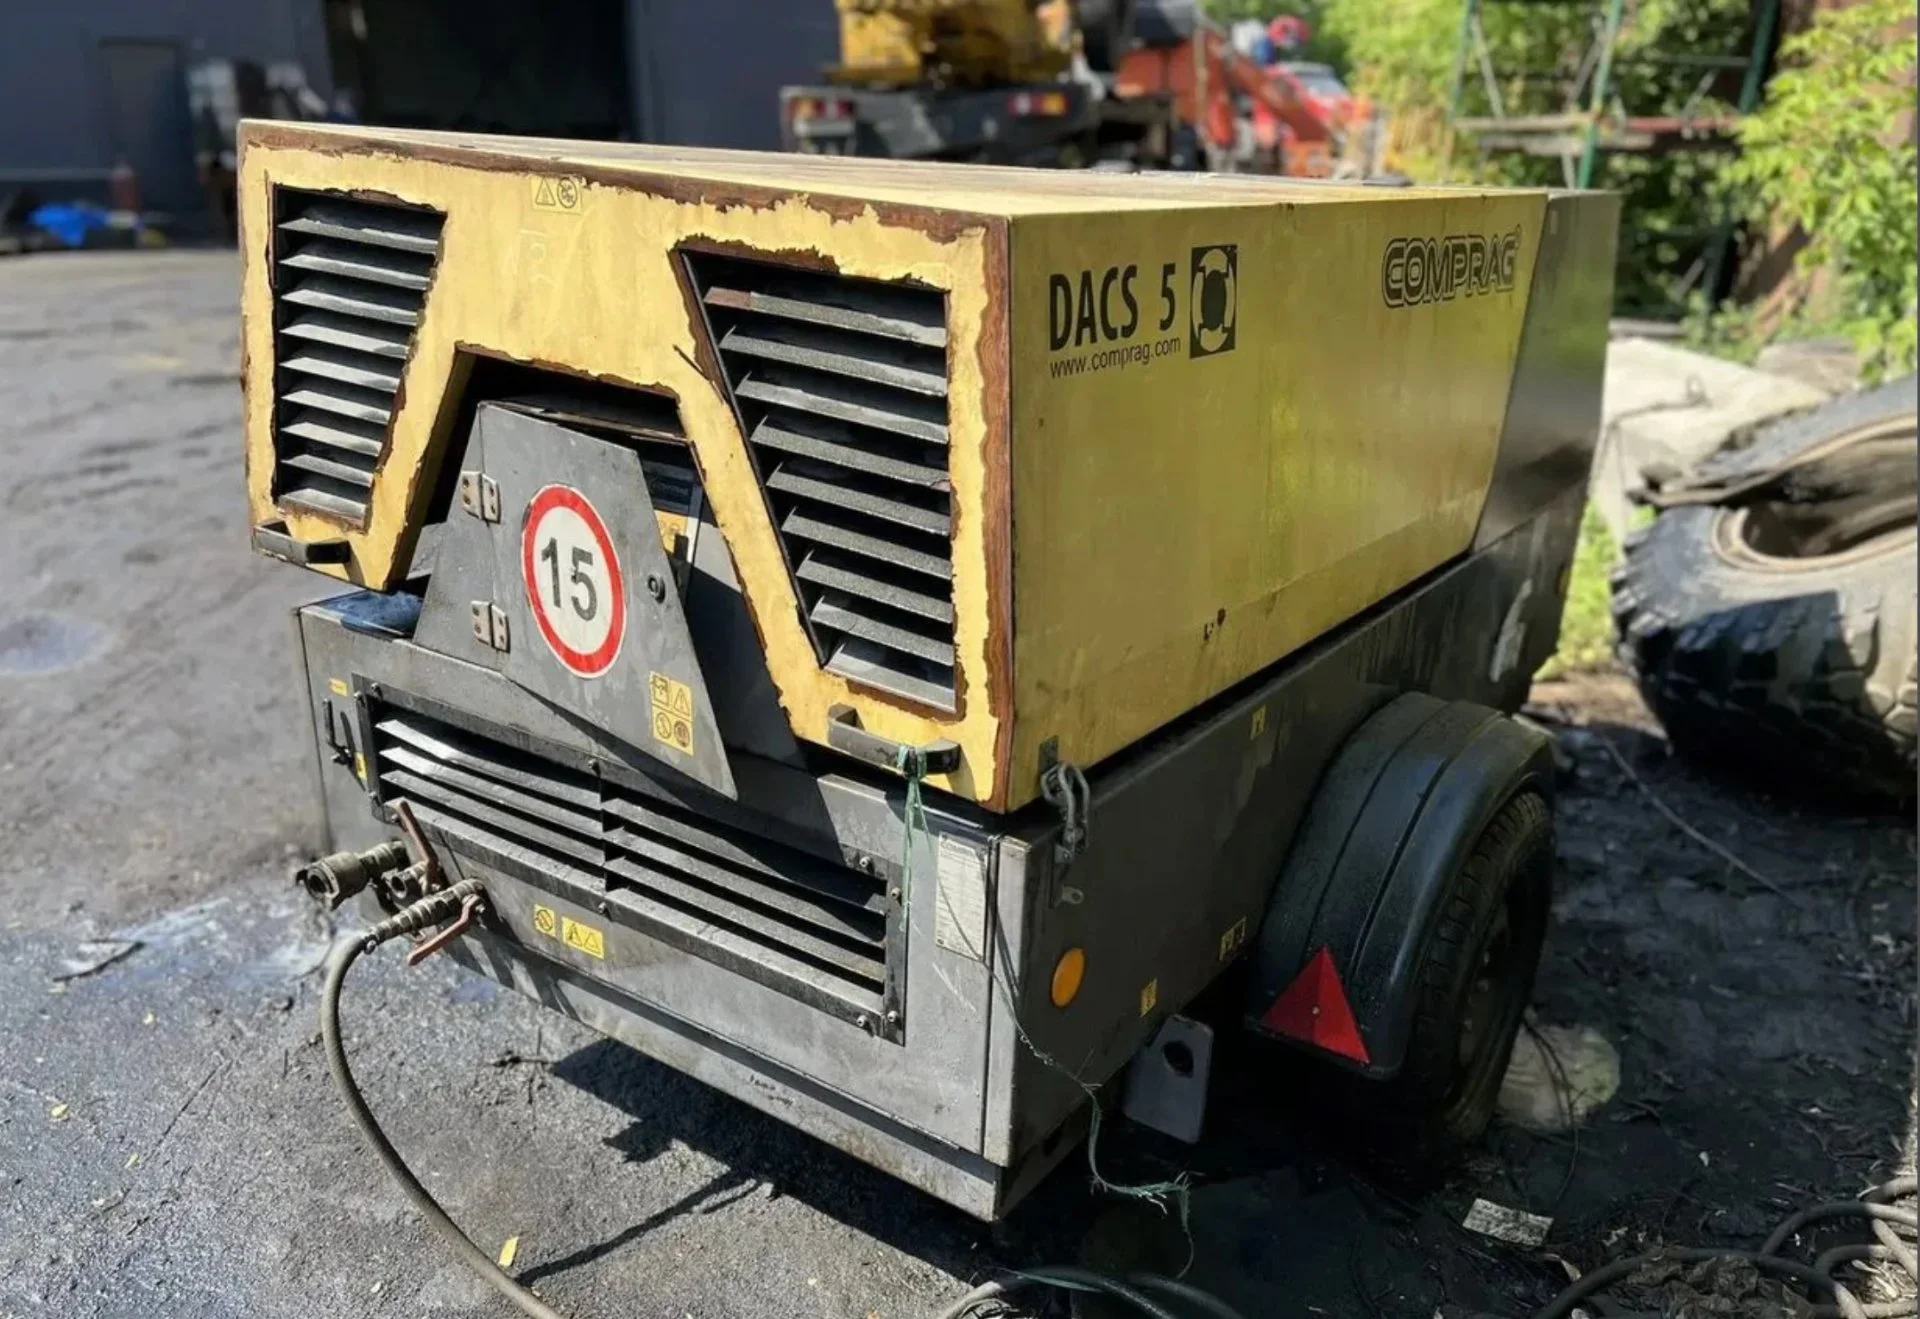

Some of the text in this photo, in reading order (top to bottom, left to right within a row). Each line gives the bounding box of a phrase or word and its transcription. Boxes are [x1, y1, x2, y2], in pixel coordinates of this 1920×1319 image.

[1050, 262, 1176, 351] DACS 5
[1050, 336, 1182, 379] www.comprag.com
[541, 537, 597, 622] 15
